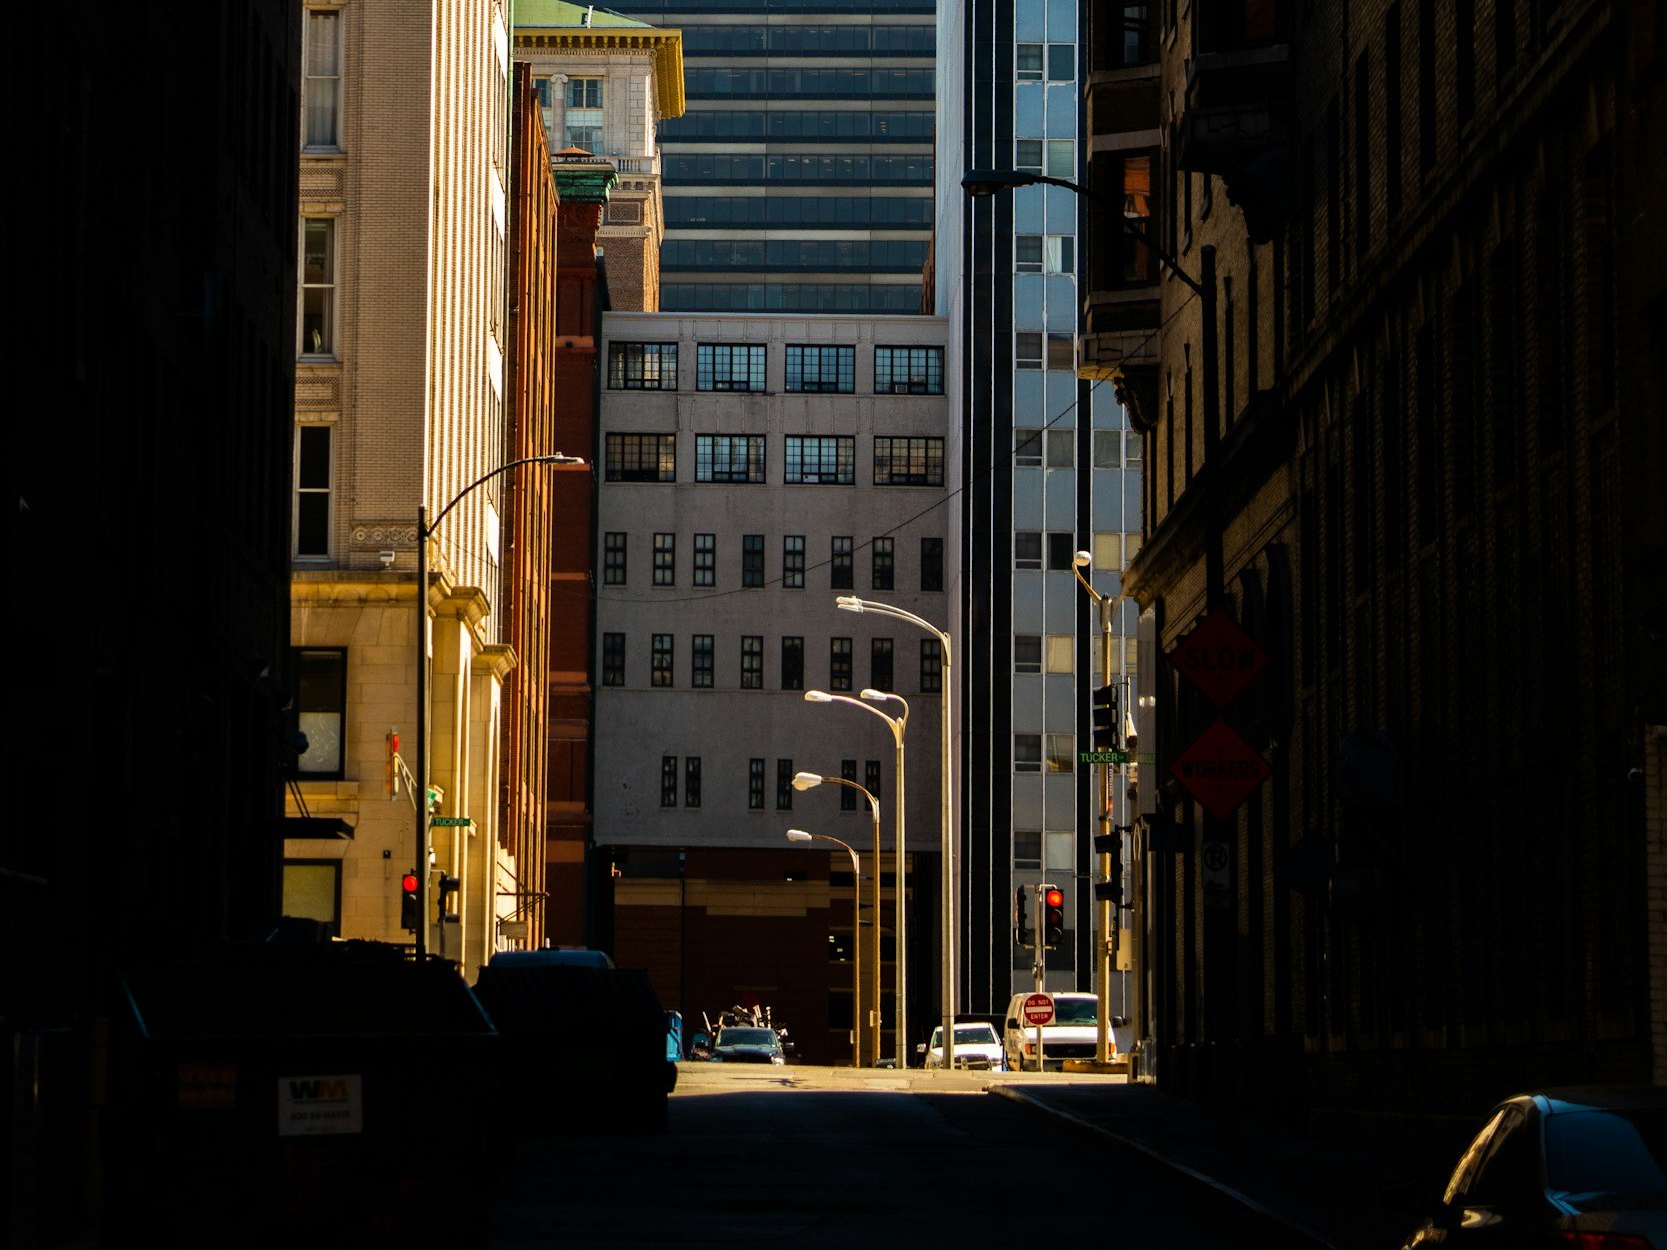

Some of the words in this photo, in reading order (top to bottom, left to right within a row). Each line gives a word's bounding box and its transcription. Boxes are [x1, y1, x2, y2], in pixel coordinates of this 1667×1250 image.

[1185, 648, 1255, 671] SLOW
[1080, 752, 1118, 763] TUCKER
[1181, 759, 1260, 778] WORKERS
[434, 818, 464, 826] TUCKER
[289, 1079, 349, 1098] WM
